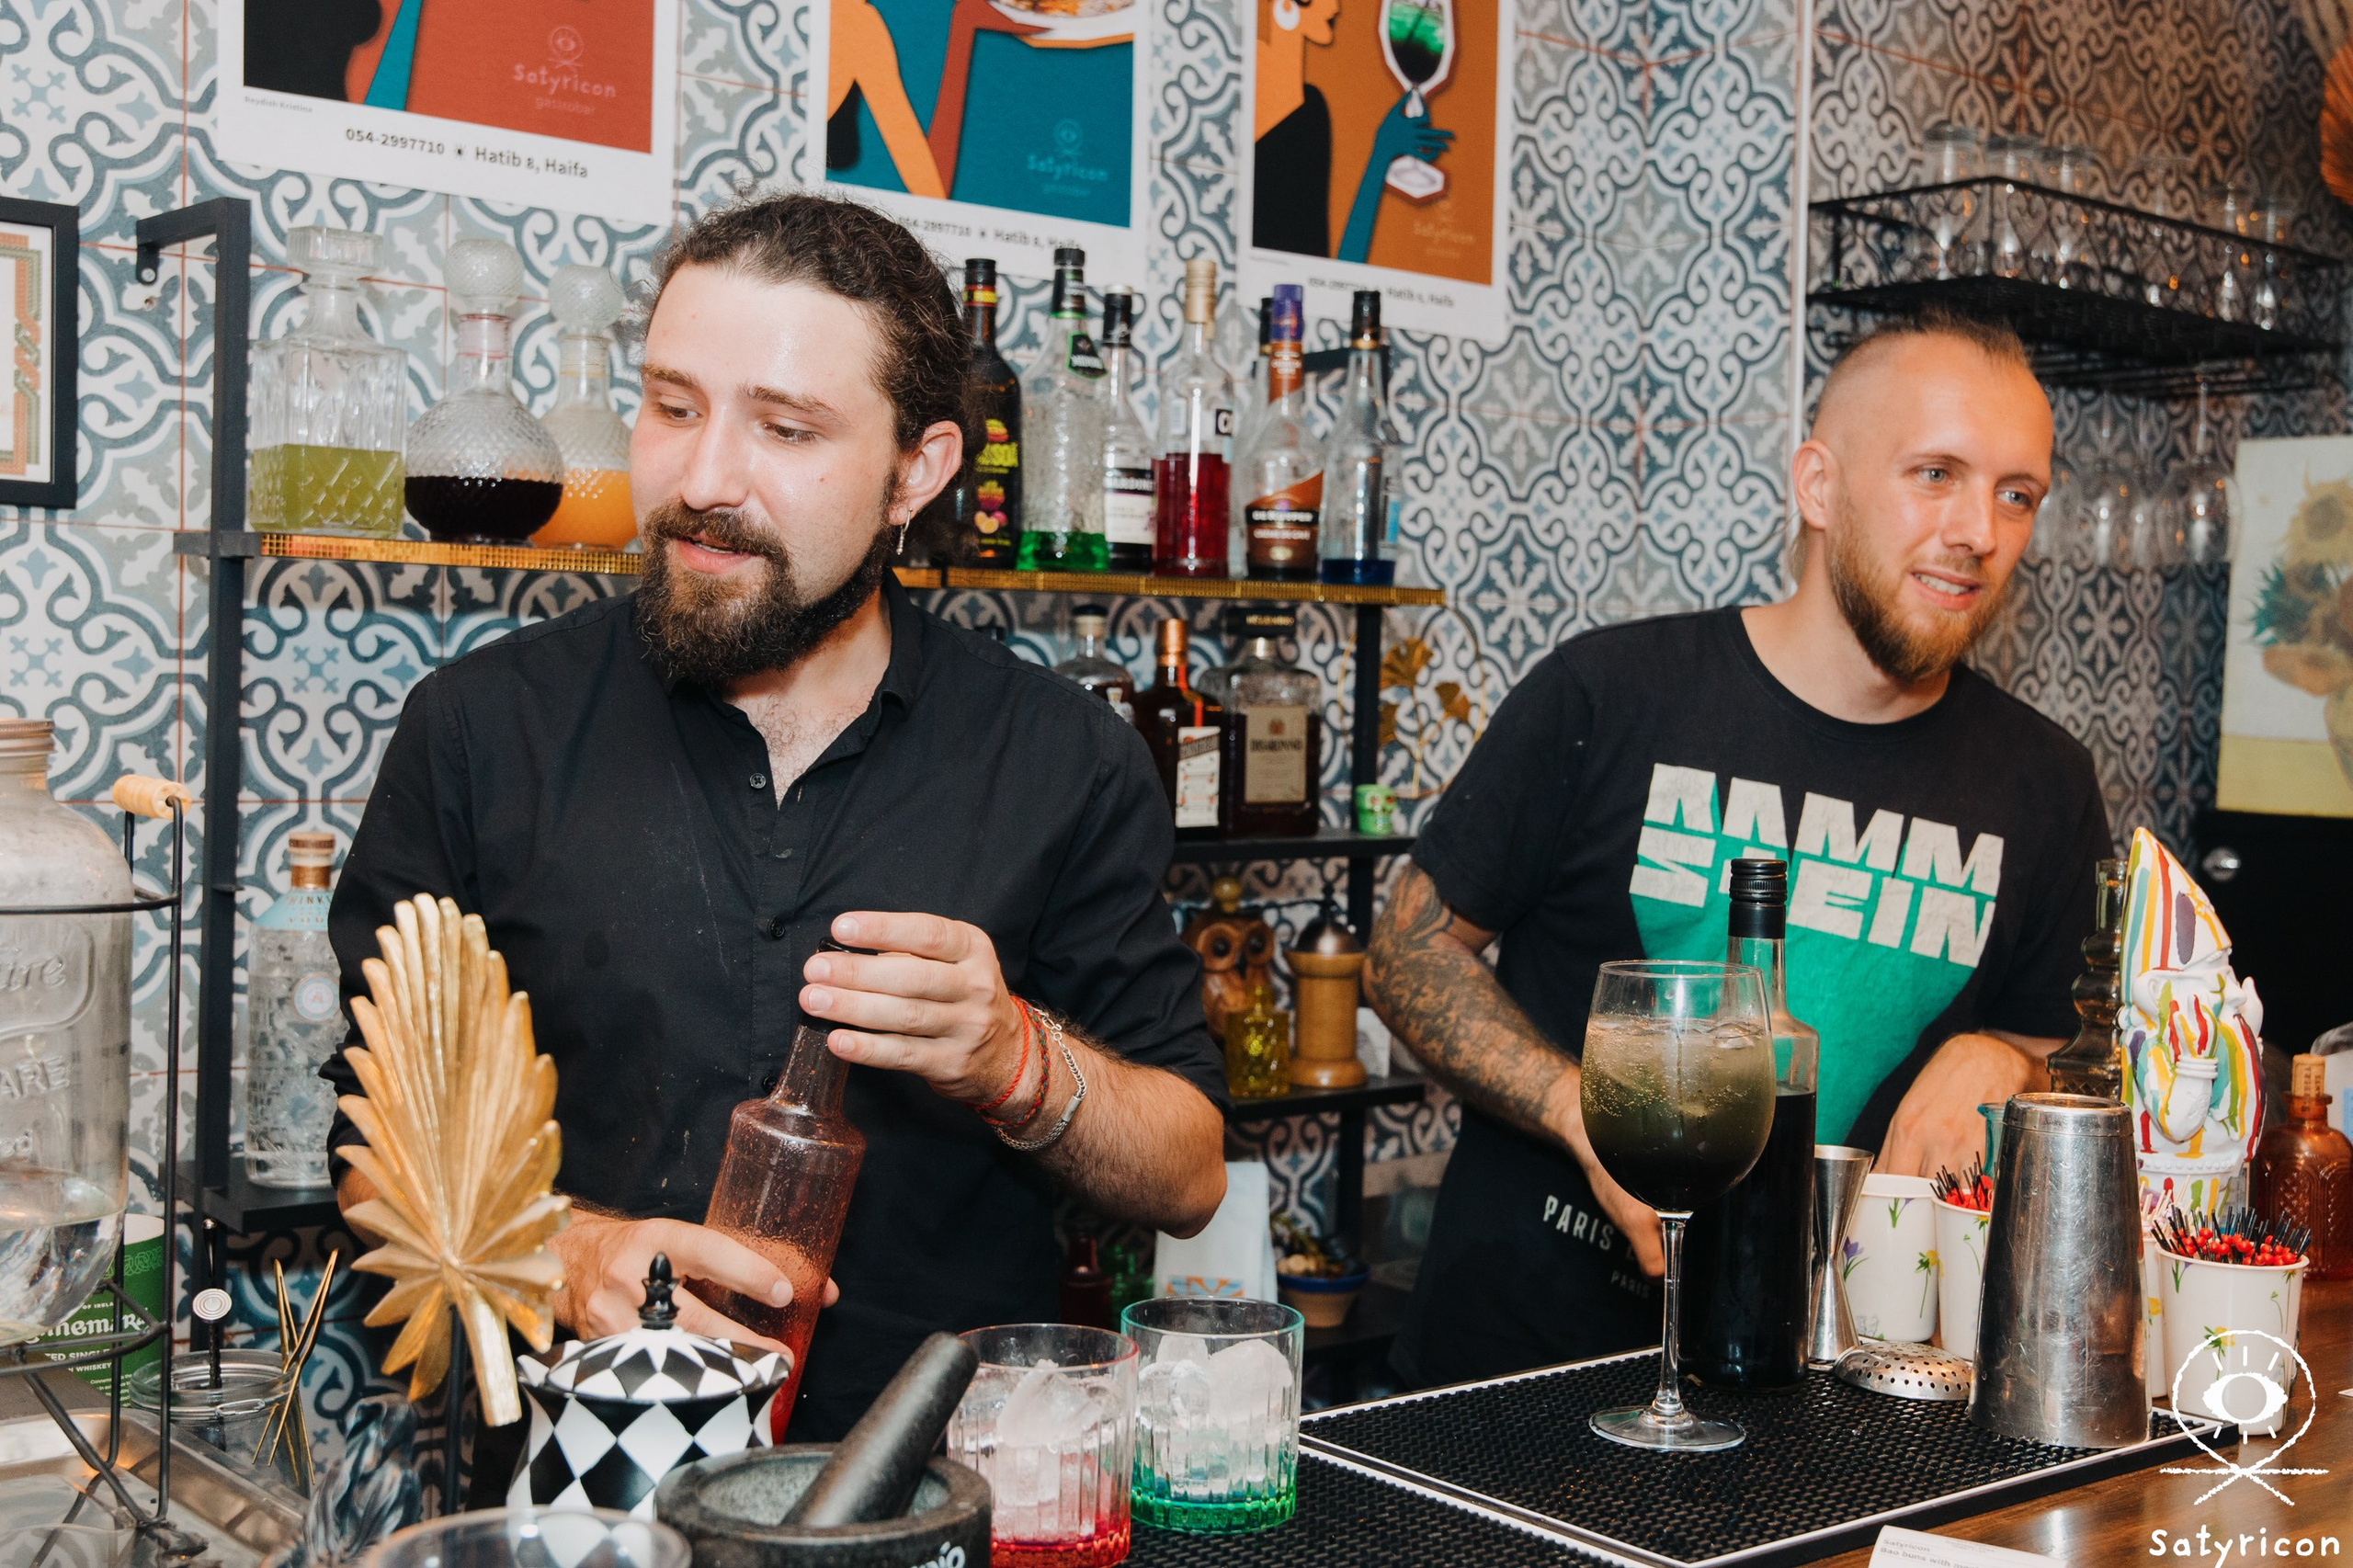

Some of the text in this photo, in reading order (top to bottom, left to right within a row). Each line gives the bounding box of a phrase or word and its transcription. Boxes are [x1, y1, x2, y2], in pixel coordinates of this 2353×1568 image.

[514, 63, 617, 98] Satyricon
[475, 146, 521, 167] Hatib
[545, 158, 588, 178] Haifa
[1542, 1195, 1615, 1251] PARIS
[75, 1362, 112, 1372] WHISKEY
[1882, 1539, 1931, 1553] Satyricon
